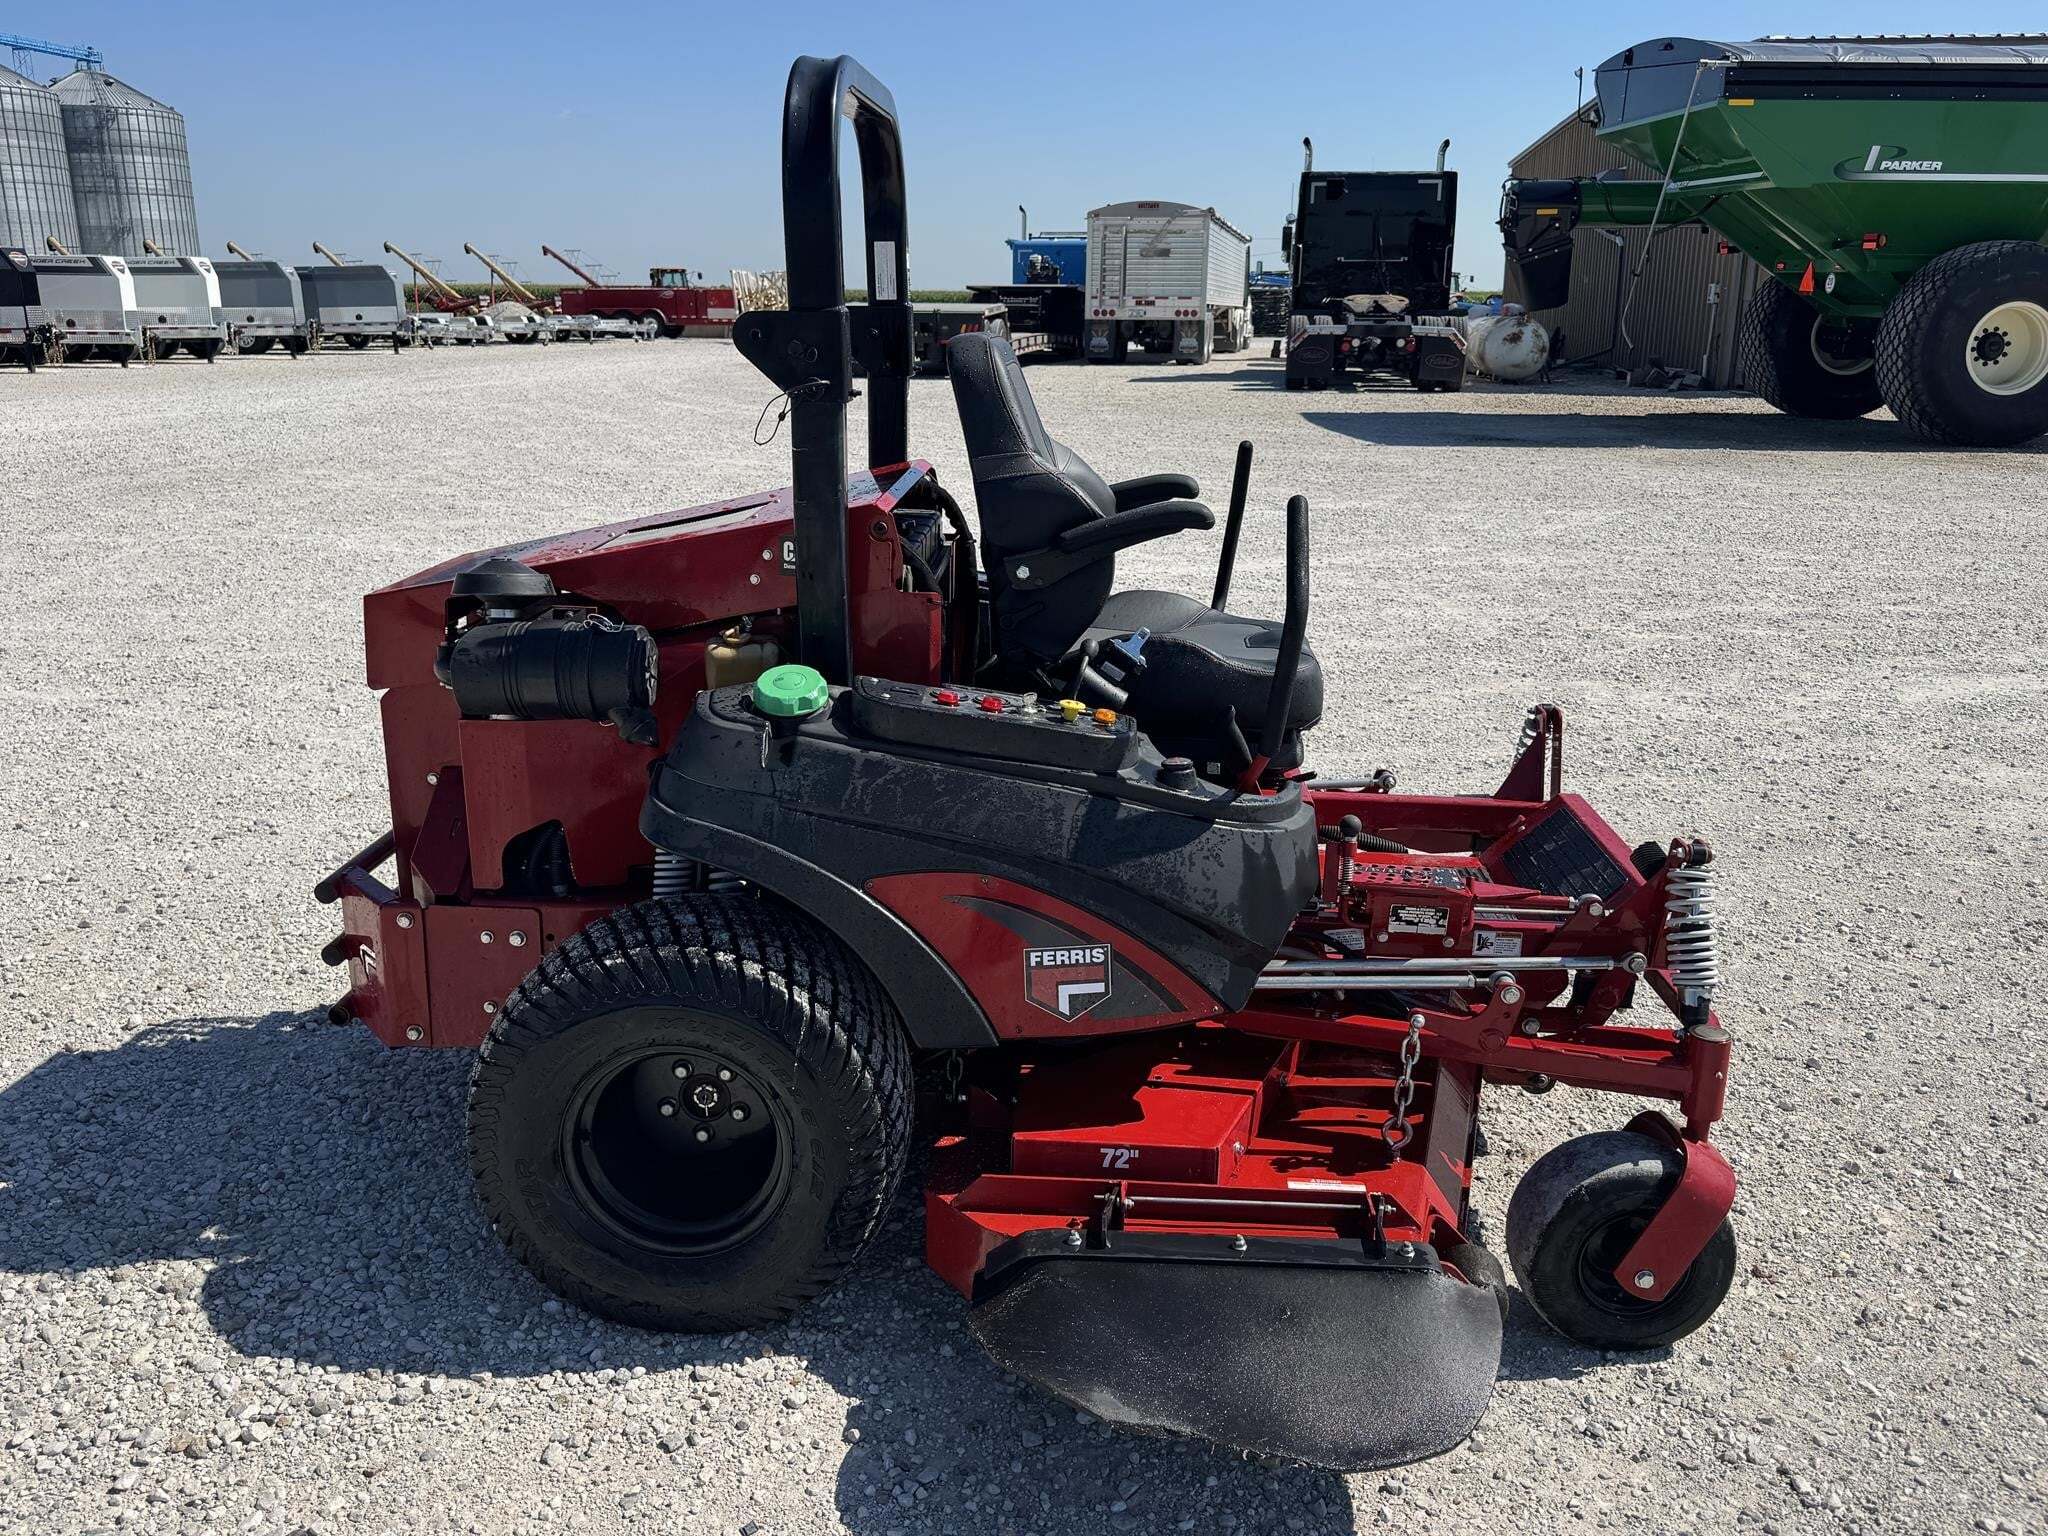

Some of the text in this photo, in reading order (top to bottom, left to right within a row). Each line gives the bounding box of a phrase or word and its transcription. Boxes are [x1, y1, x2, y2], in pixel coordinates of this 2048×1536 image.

[1879, 160, 1943, 171] PARKER
[783, 541, 796, 562] C
[1030, 948, 1105, 967] FERRIS
[1100, 1147, 1140, 1169] 72"
